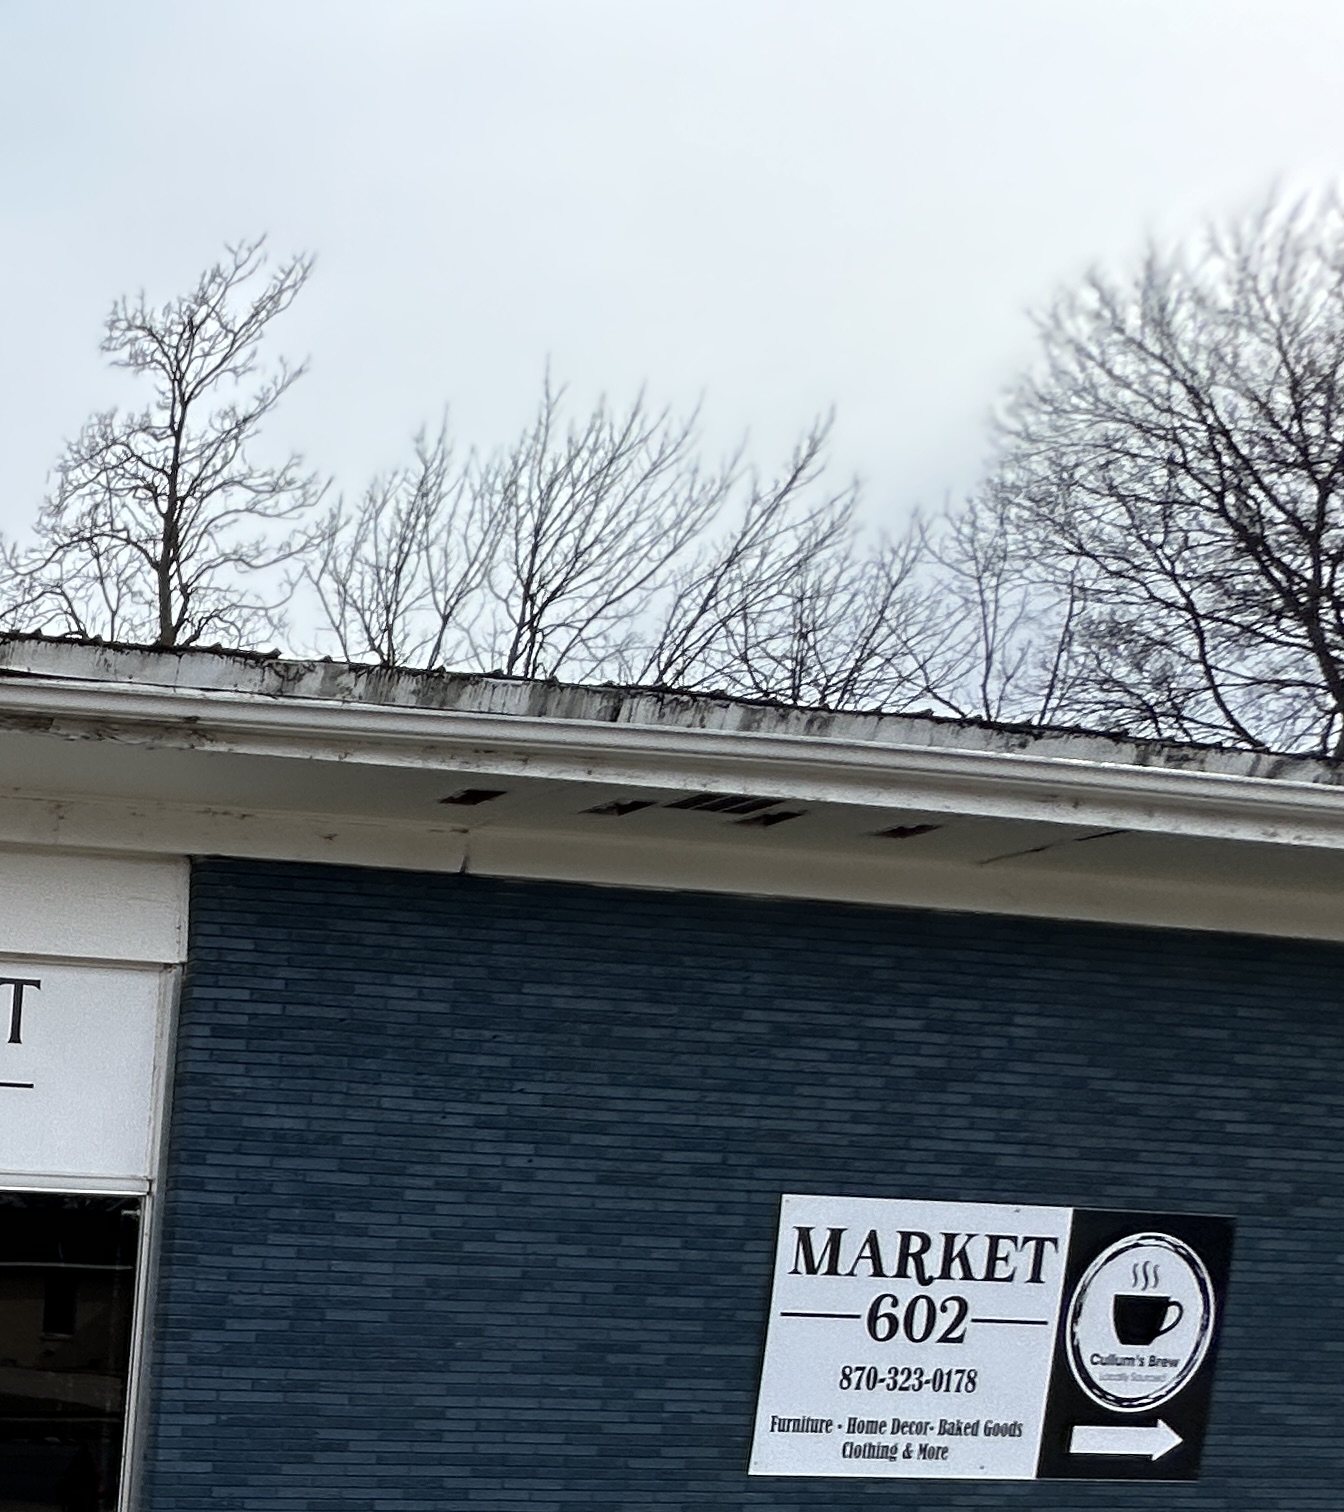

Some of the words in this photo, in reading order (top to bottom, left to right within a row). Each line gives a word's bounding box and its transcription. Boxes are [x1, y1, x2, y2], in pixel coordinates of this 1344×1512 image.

[787, 1226, 1059, 1286] MARKET
[866, 1294, 969, 1344] 602
[1148, 1355, 1180, 1367] Brew
[839, 1366, 978, 1393] 870-323-0178
[769, 1415, 833, 1434] Furniture
[846, 1417, 887, 1436] Home
[937, 1419, 979, 1437] Baked
[983, 1420, 1023, 1437] Goods
[842, 1441, 897, 1461] Clothing
[902, 1442, 913, 1460] &
[917, 1443, 949, 1460] More
